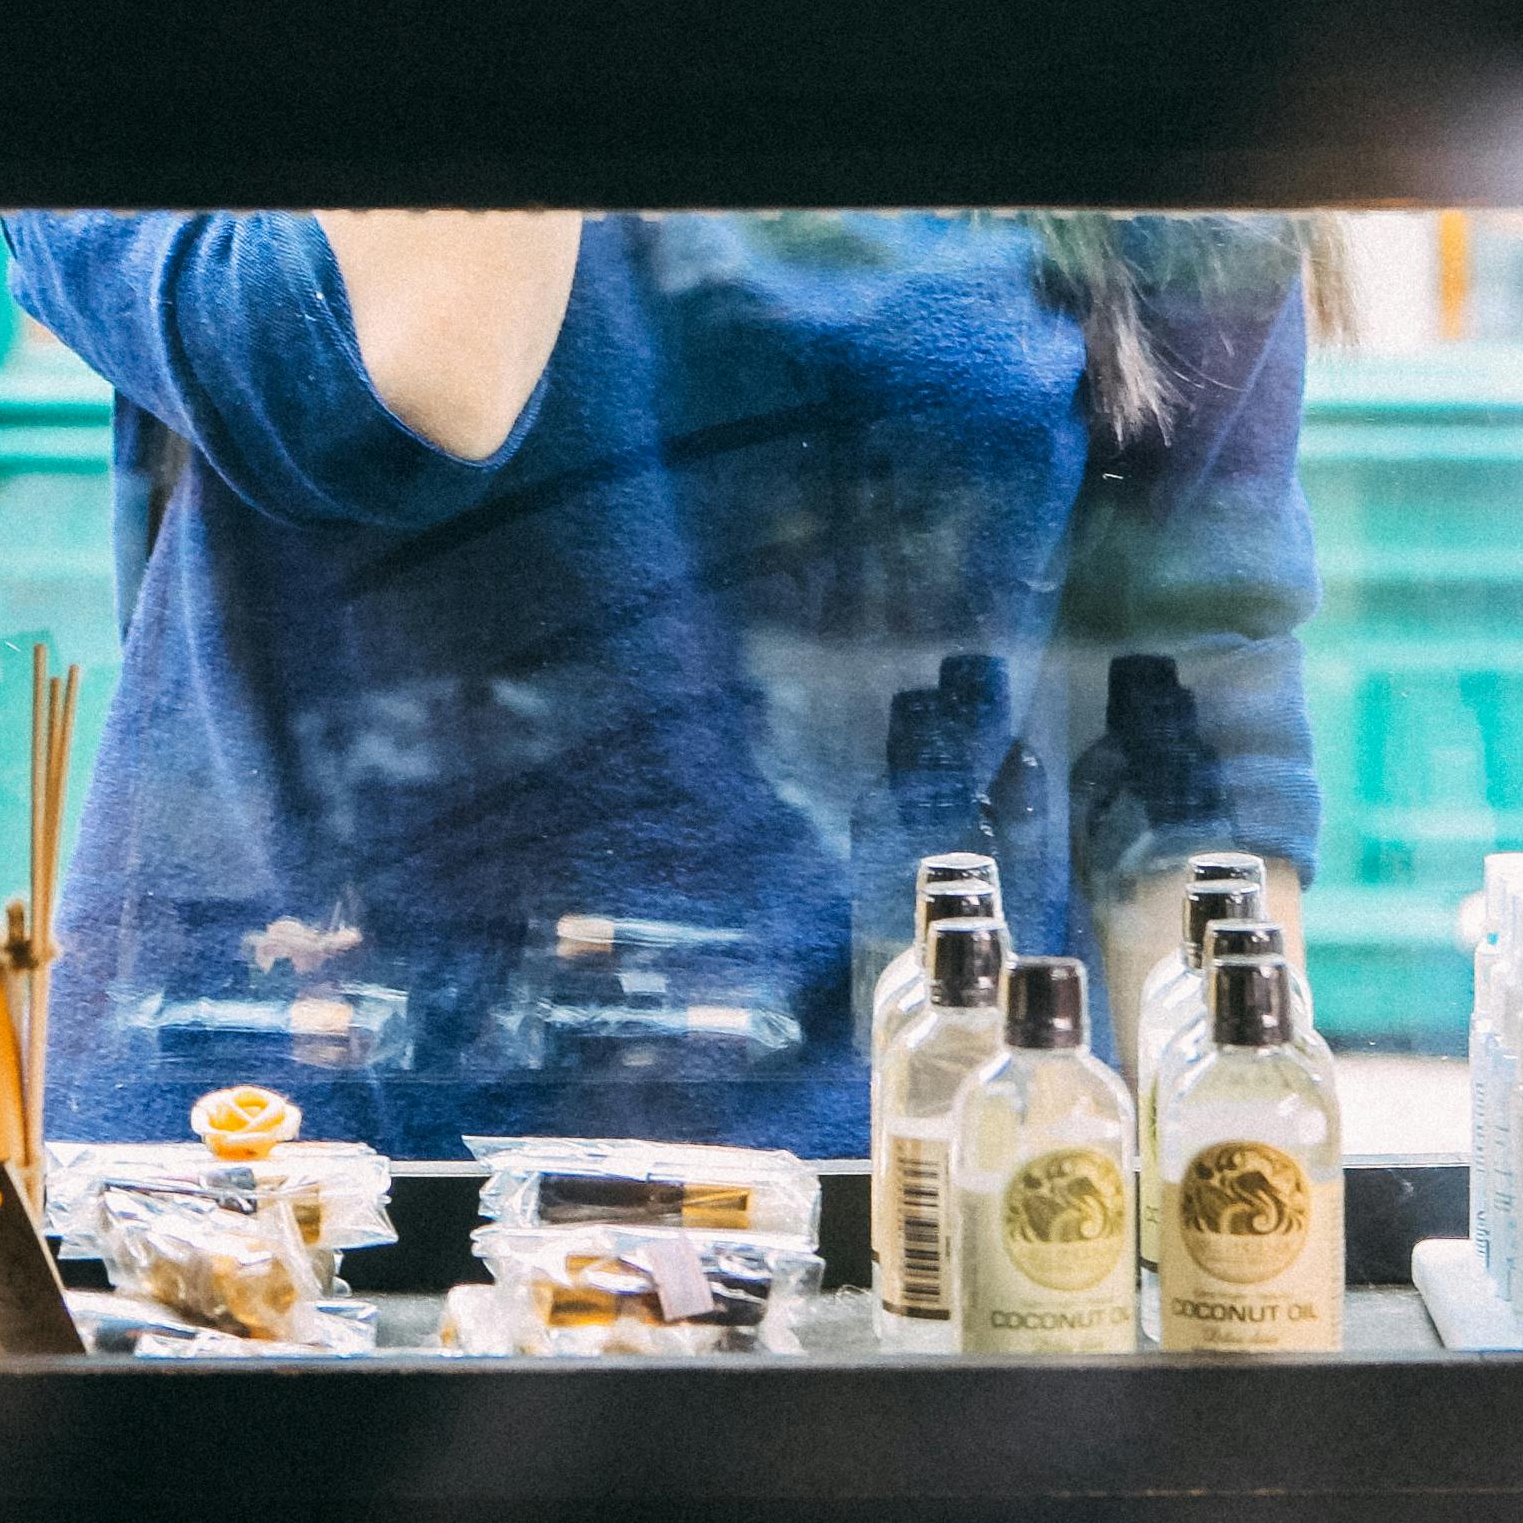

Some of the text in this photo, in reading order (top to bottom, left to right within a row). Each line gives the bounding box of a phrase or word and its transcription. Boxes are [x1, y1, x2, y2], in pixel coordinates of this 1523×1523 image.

[990, 1308, 1105, 1330] COCONUT
[1171, 1297, 1319, 1323] COCONUT OIL
